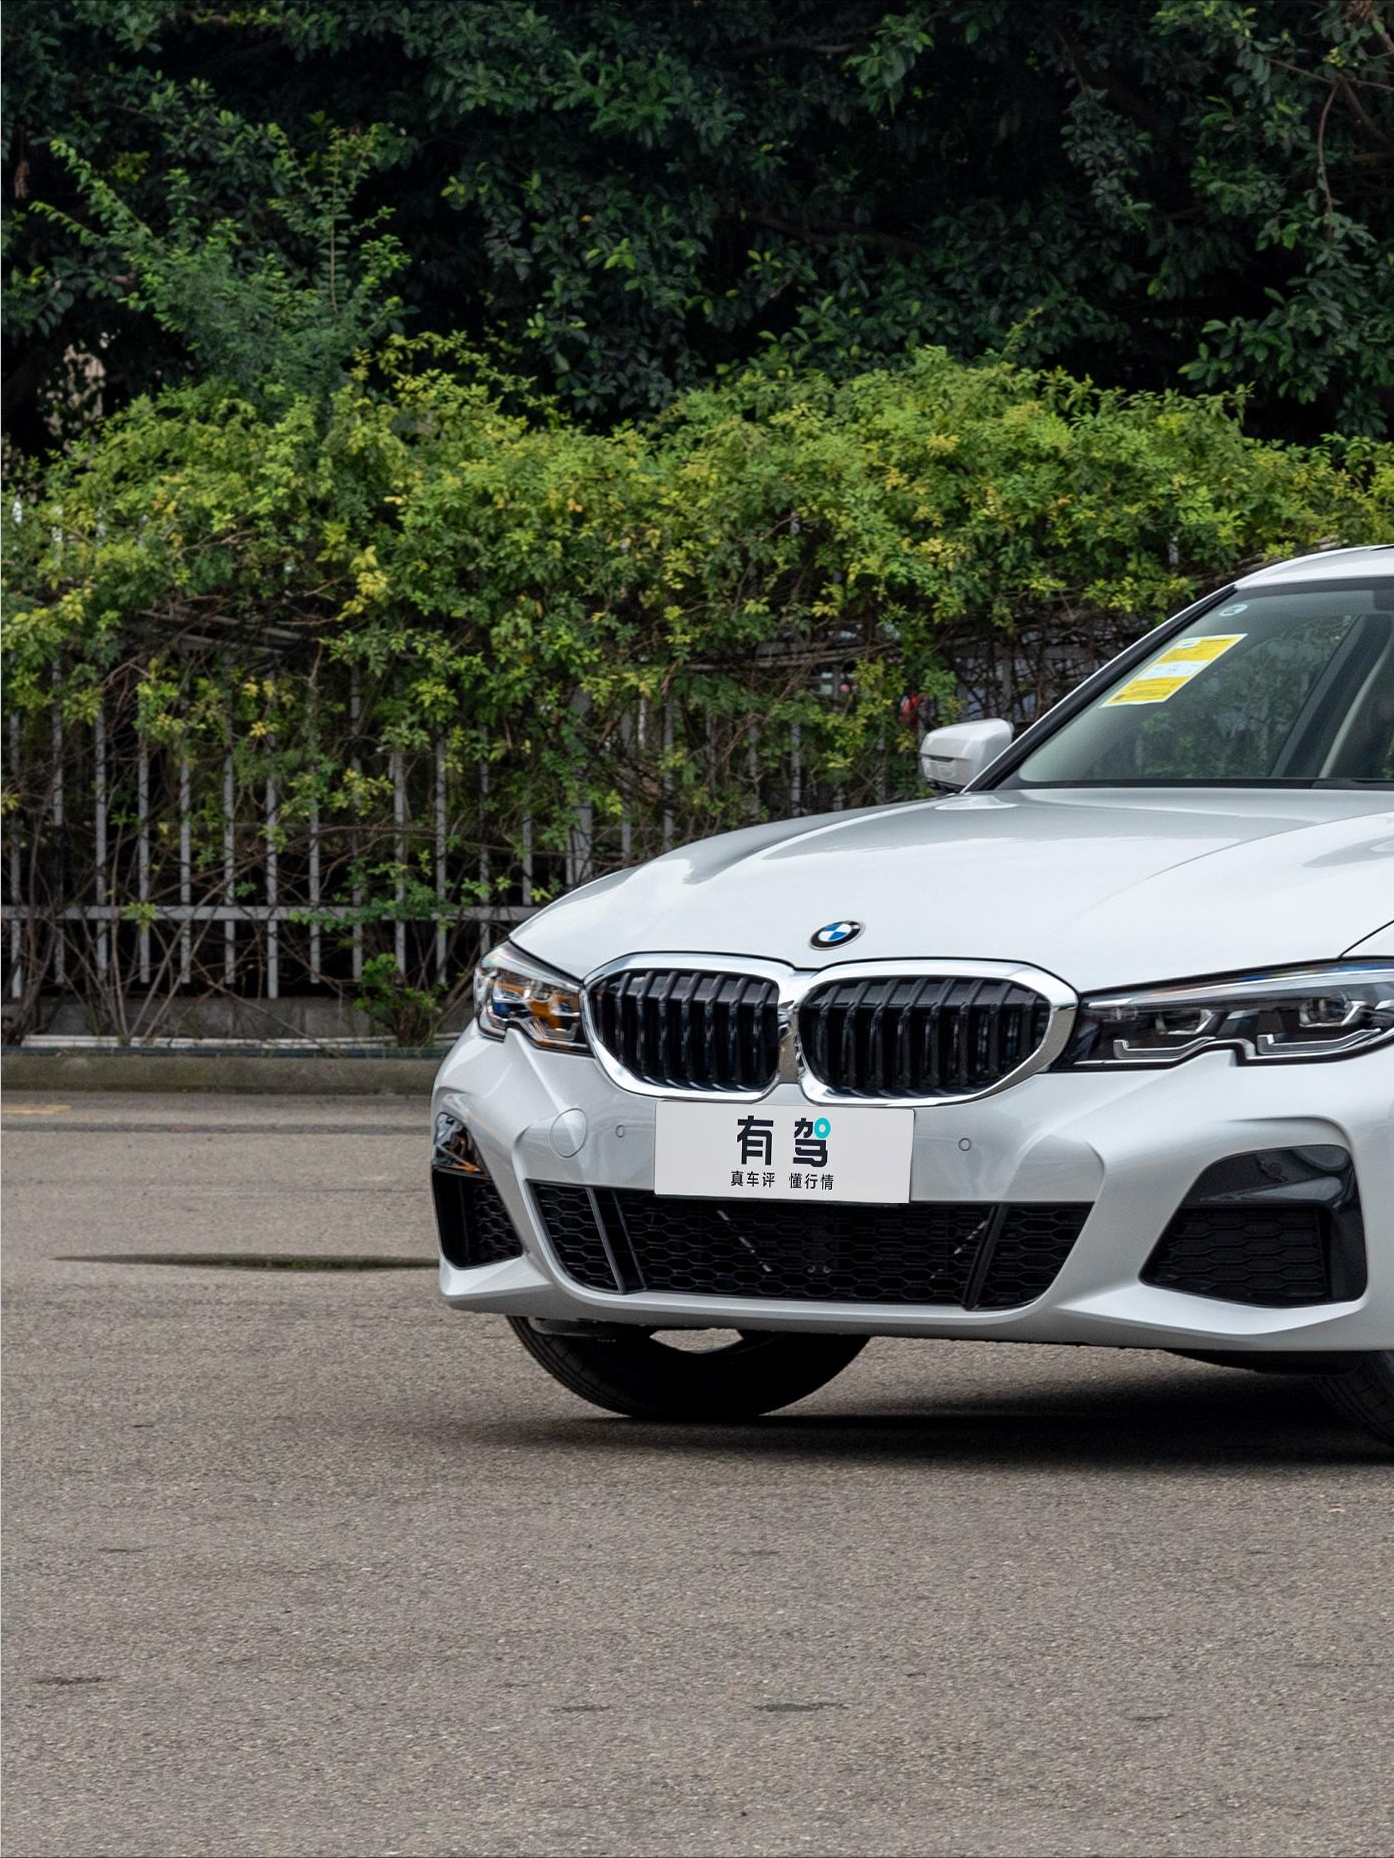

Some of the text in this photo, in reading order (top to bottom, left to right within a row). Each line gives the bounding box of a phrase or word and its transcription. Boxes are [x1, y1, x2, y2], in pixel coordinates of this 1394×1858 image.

[736, 1115, 831, 1167] 有驾
[730, 1170, 834, 1191] 真车评 懂行情
